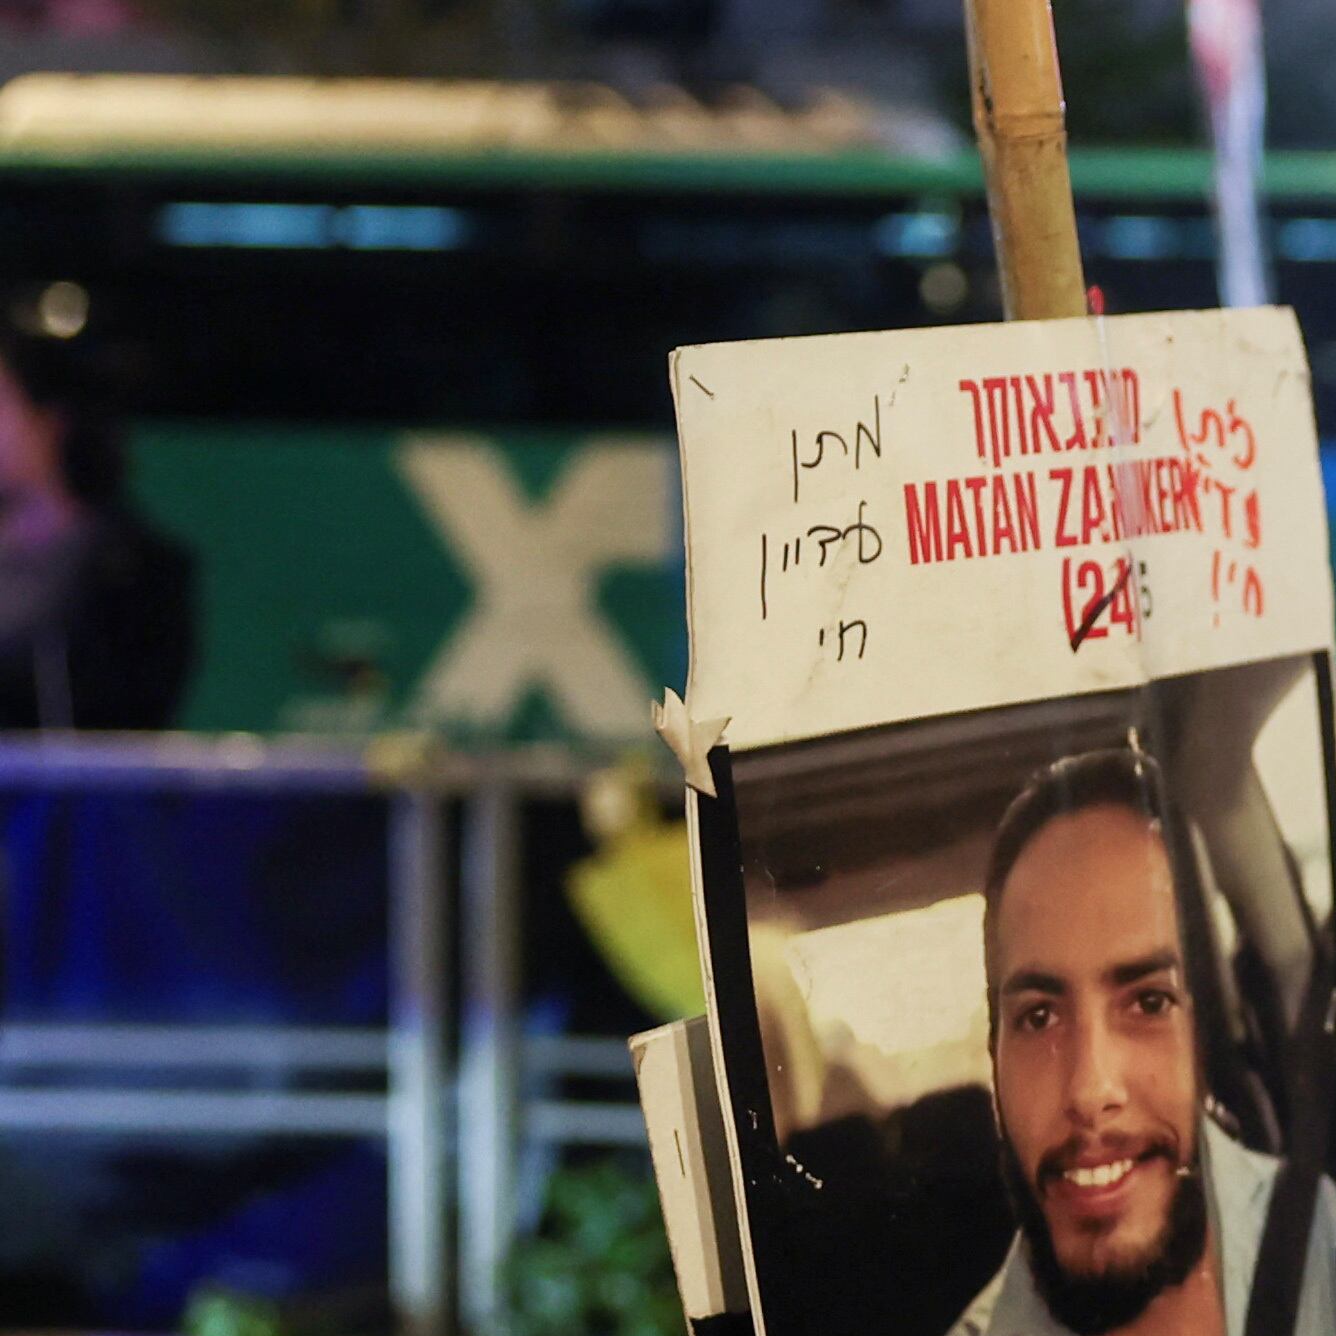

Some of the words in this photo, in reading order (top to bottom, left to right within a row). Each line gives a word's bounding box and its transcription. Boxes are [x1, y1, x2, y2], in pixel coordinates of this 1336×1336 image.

[791, 394, 882, 503] מתן
[760, 500, 882, 621] עדיין
[903, 471, 1042, 565] MATAN
[818, 619, 868, 662] חי
